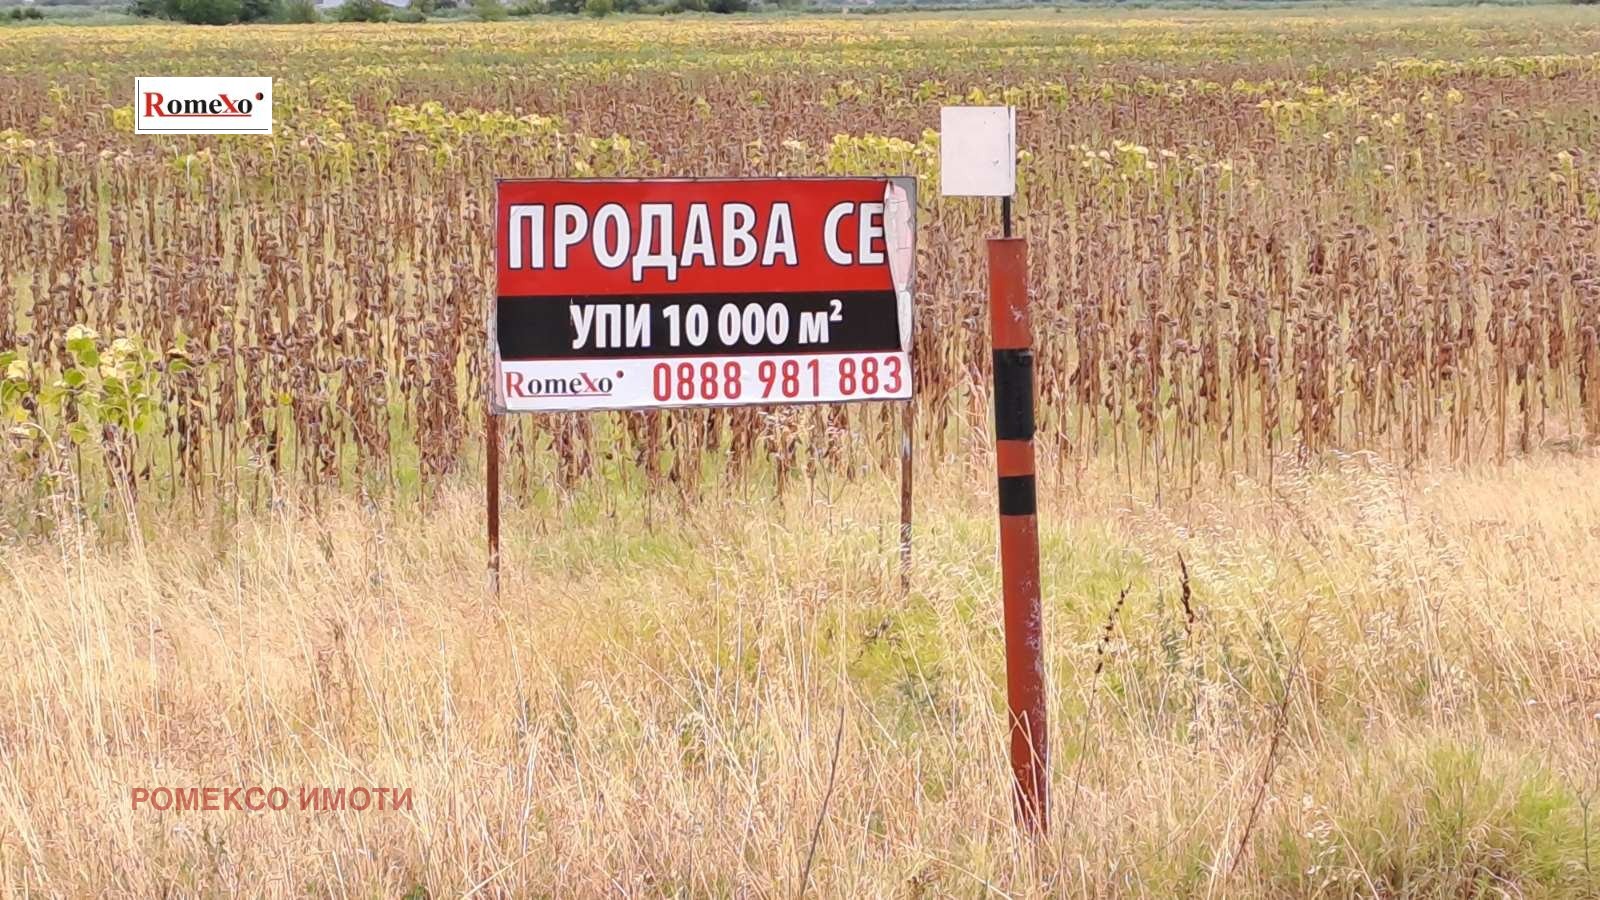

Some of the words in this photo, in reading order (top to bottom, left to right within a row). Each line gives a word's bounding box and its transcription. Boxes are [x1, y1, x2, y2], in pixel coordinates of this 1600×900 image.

[508, 201, 798, 282] ПРОДАВА
[823, 201, 885, 266] СЕ
[570, 302, 651, 350] УПИ
[662, 303, 709, 347] 10
[717, 302, 790, 346] 000
[652, 361, 742, 402] 0888
[758, 358, 820, 398] 981
[838, 355, 902, 396] 883
